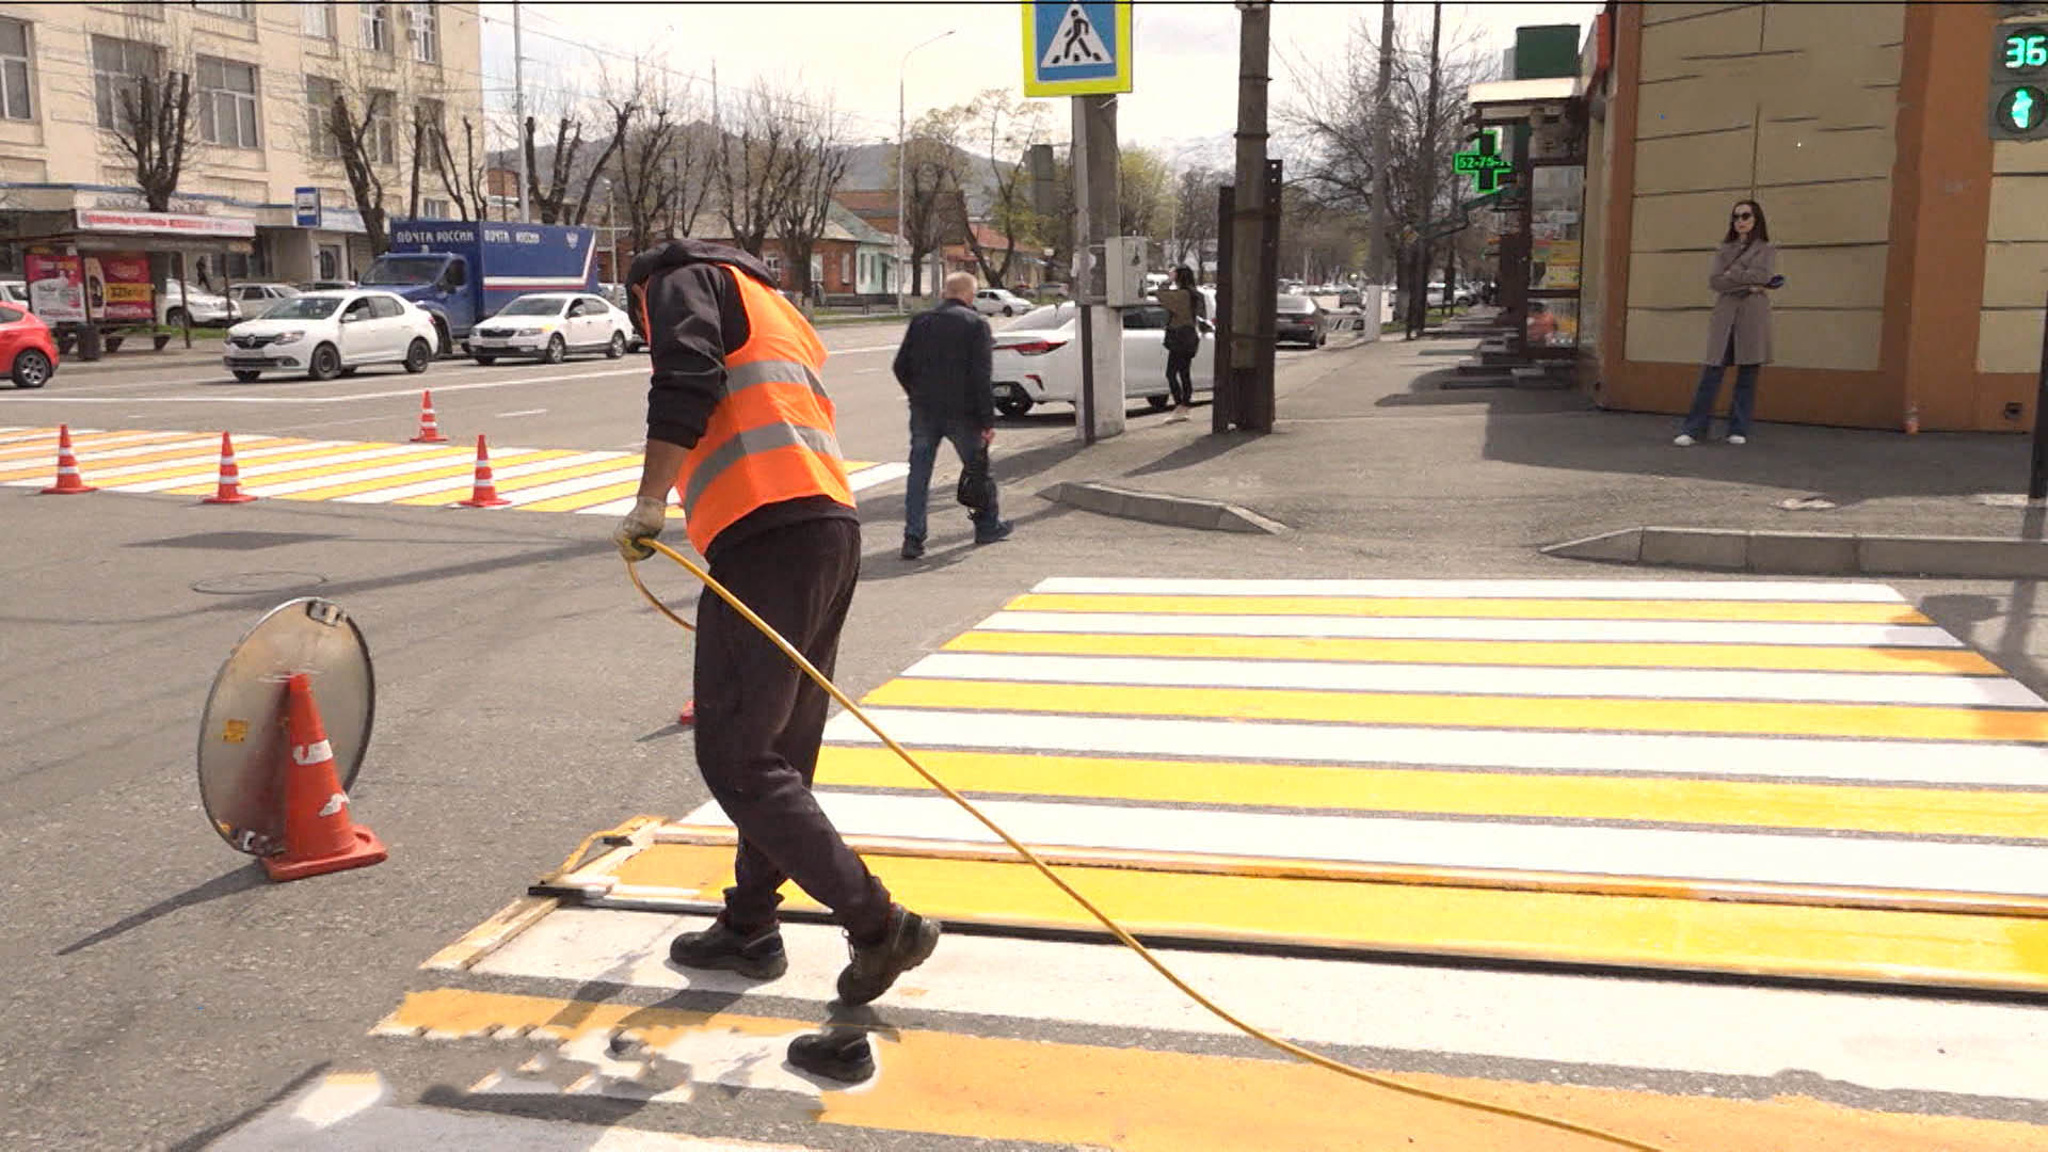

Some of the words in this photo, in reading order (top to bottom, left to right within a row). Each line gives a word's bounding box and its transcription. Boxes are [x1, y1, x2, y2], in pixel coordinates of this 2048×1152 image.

[2005, 36, 2047, 68] 36
[397, 230, 434, 244] ПОЧТА
[436, 229, 475, 243] РОССИИ
[484, 229, 511, 243] ПОЧТА
